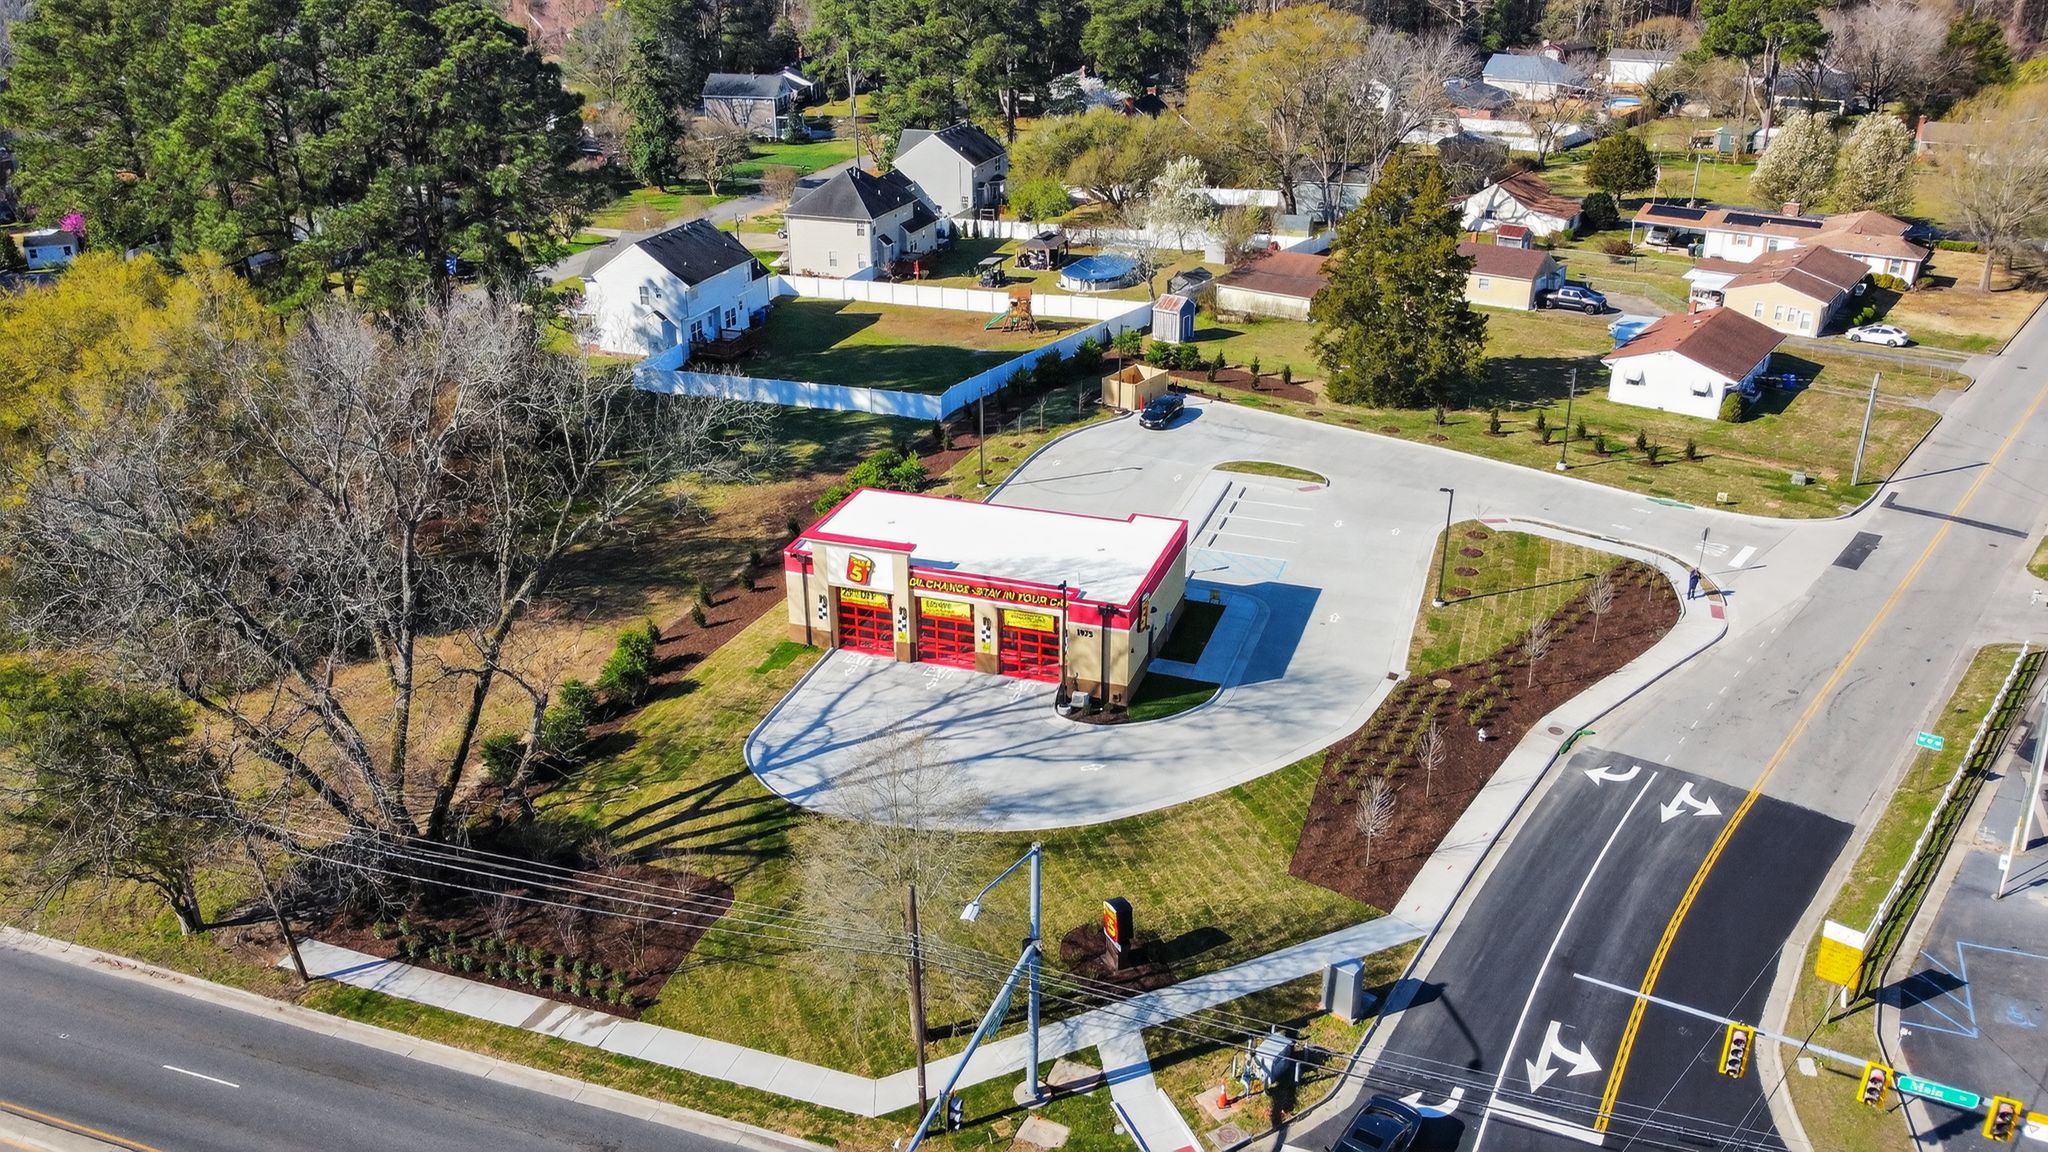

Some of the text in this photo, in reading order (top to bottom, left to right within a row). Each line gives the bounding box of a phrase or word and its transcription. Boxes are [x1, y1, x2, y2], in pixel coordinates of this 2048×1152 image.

[849, 565, 863, 582] 5
[909, 577, 925, 588] OIL
[925, 580, 970, 594] CHANGE
[1003, 591, 1015, 601] IN
[1018, 593, 1047, 605] YOUR
[1910, 1081, 1944, 1098] Main
